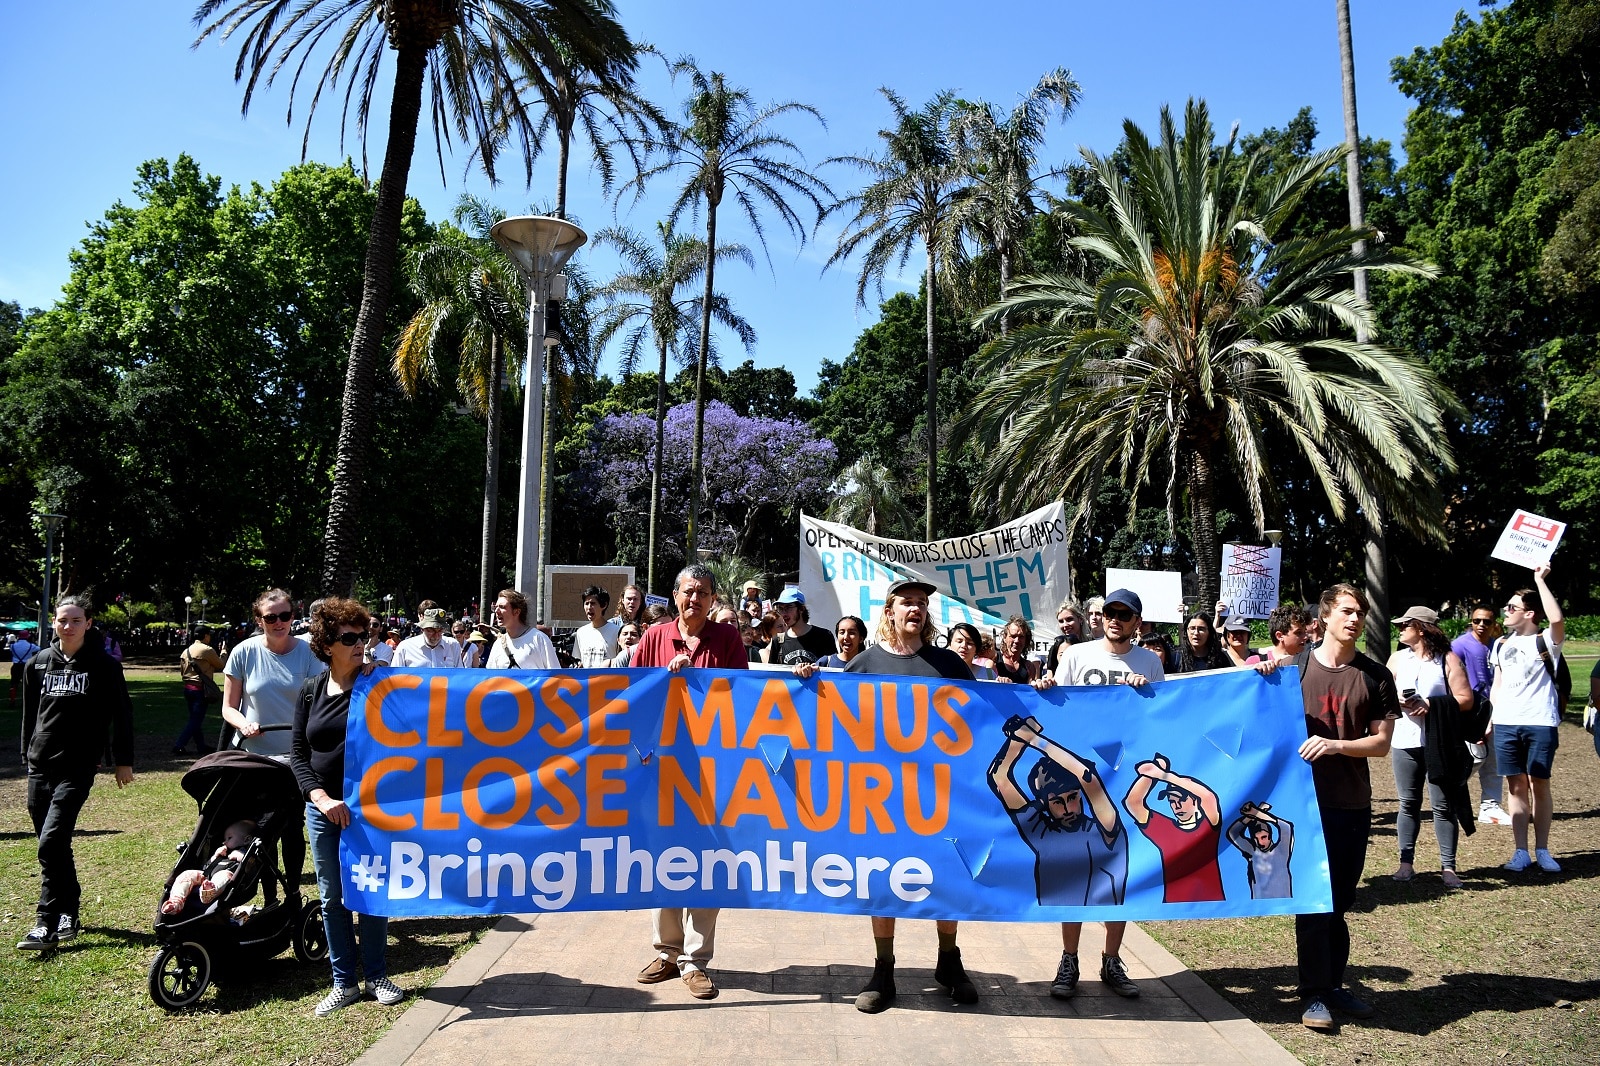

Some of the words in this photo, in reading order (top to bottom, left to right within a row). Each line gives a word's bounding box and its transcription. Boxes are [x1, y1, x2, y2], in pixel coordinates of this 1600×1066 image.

[847, 540, 874, 556] HE
[942, 534, 990, 560] CLOSE
[1018, 518, 1064, 551] CAMPS
[1509, 532, 1530, 544] BRING
[1530, 538, 1549, 550] THEM
[821, 551, 909, 582] BRIN
[935, 551, 1047, 597] THEM
[1221, 575, 1248, 590] HUMAN
[1251, 576, 1275, 591] BEINGS
[1222, 587, 1242, 599] WHO
[1244, 589, 1275, 600] DESERVE
[859, 585, 1035, 630] HRE!
[1227, 599, 1236, 615] A
[1238, 599, 1270, 616] CHANCE
[366, 674, 631, 748] CLOSE
[659, 676, 973, 756] MANUS
[359, 754, 629, 831] CLOSE
[658, 756, 951, 836] NAURU
[351, 835, 934, 911] #BringThemHere
